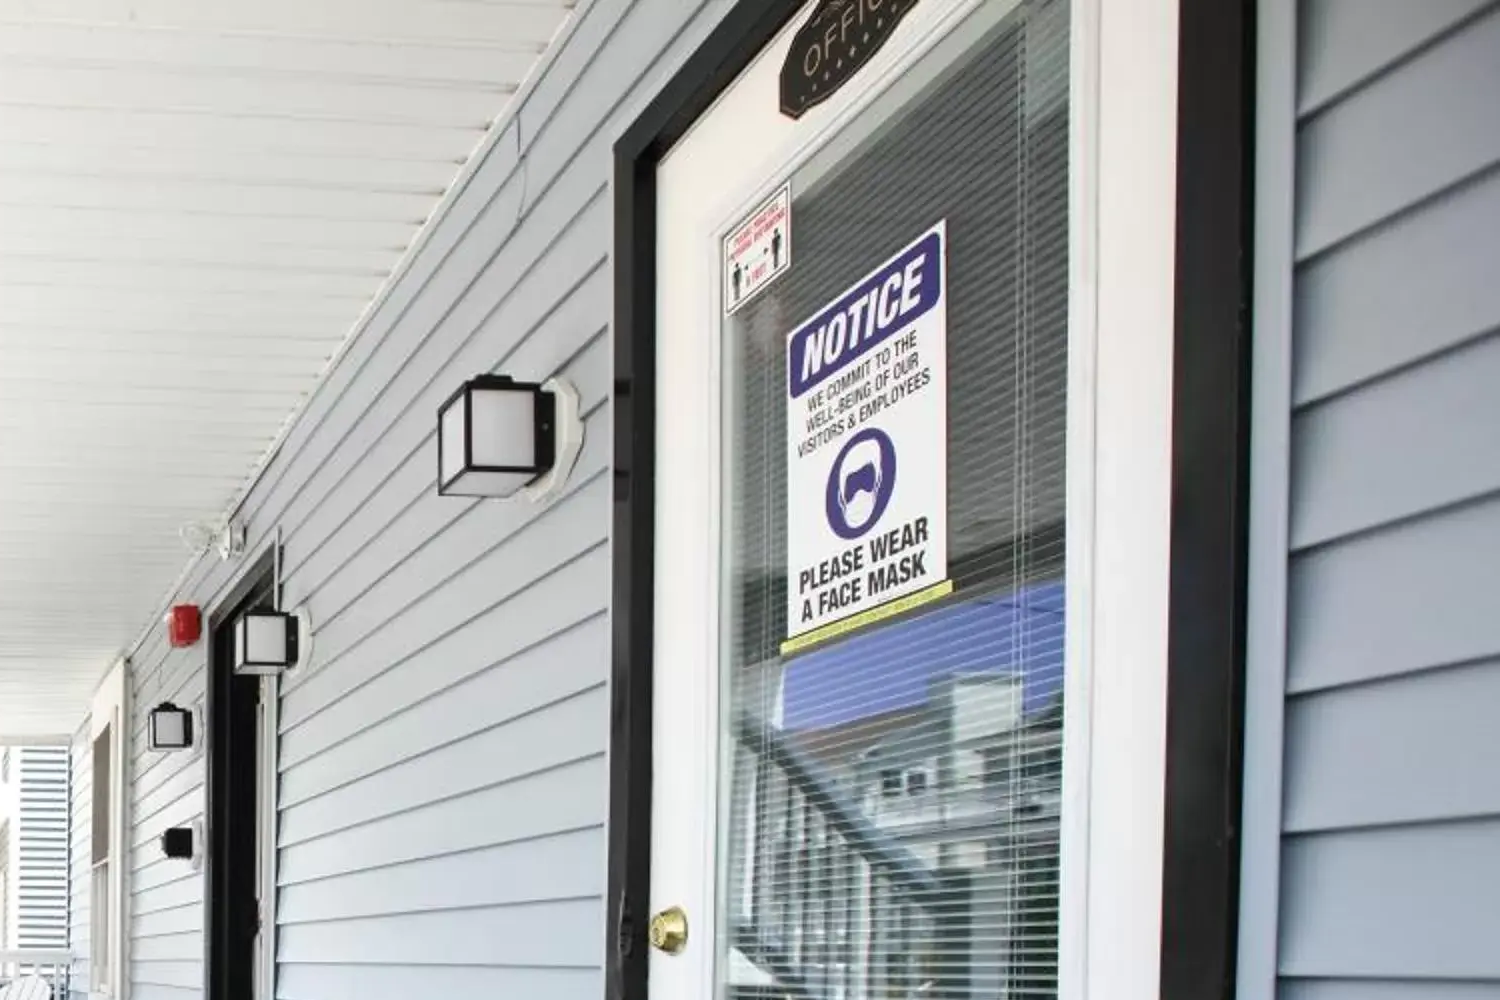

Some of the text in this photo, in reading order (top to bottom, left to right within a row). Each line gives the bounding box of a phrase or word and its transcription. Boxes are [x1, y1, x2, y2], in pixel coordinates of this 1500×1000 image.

[801, 253, 926, 382] NOTICE
[806, 352, 919, 433] WELL-BEING OF OUR
[807, 330, 917, 412] WE COMMIT TO THE
[798, 367, 931, 458] VISITORS & EMPLOYEES
[800, 516, 928, 594] PLEASE WEAR
[801, 551, 926, 622] A FACE MASK
